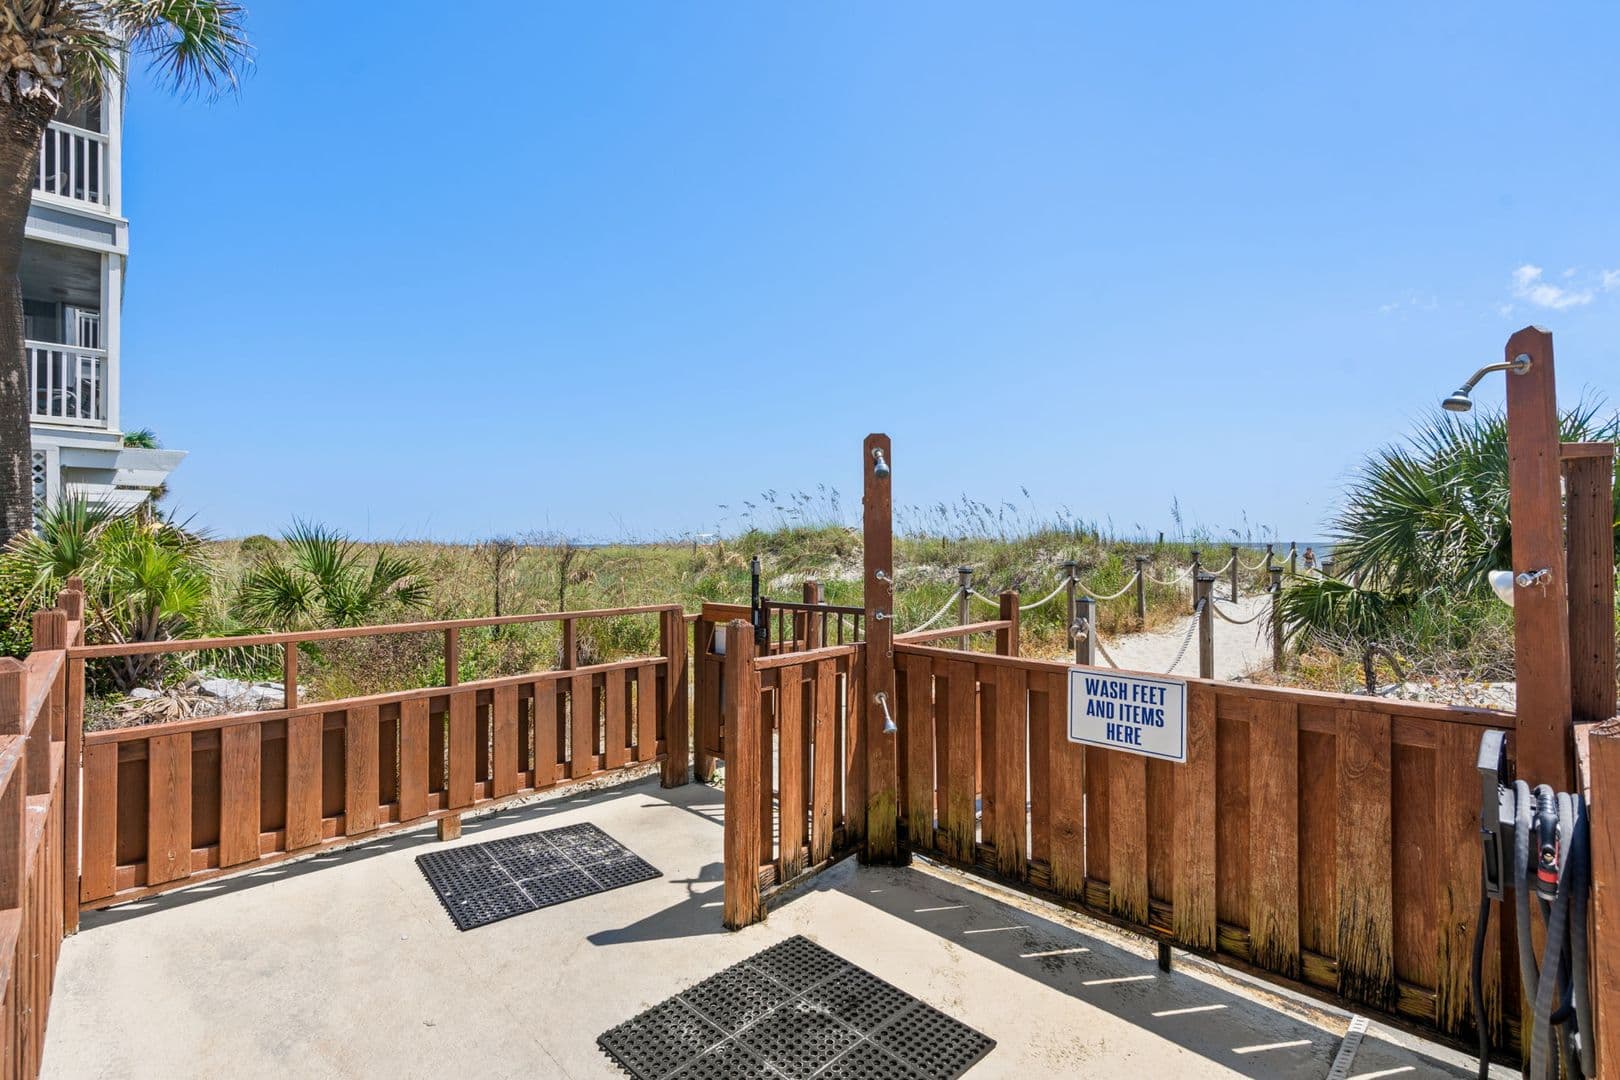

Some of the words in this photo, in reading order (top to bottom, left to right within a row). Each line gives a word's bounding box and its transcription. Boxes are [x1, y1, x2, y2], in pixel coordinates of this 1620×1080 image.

[1085, 678, 1127, 700] WASH
[1132, 684, 1166, 706] FEET
[1086, 699, 1114, 719] AND
[1119, 703, 1164, 728] ITEMS
[1106, 722, 1142, 746] HERE
